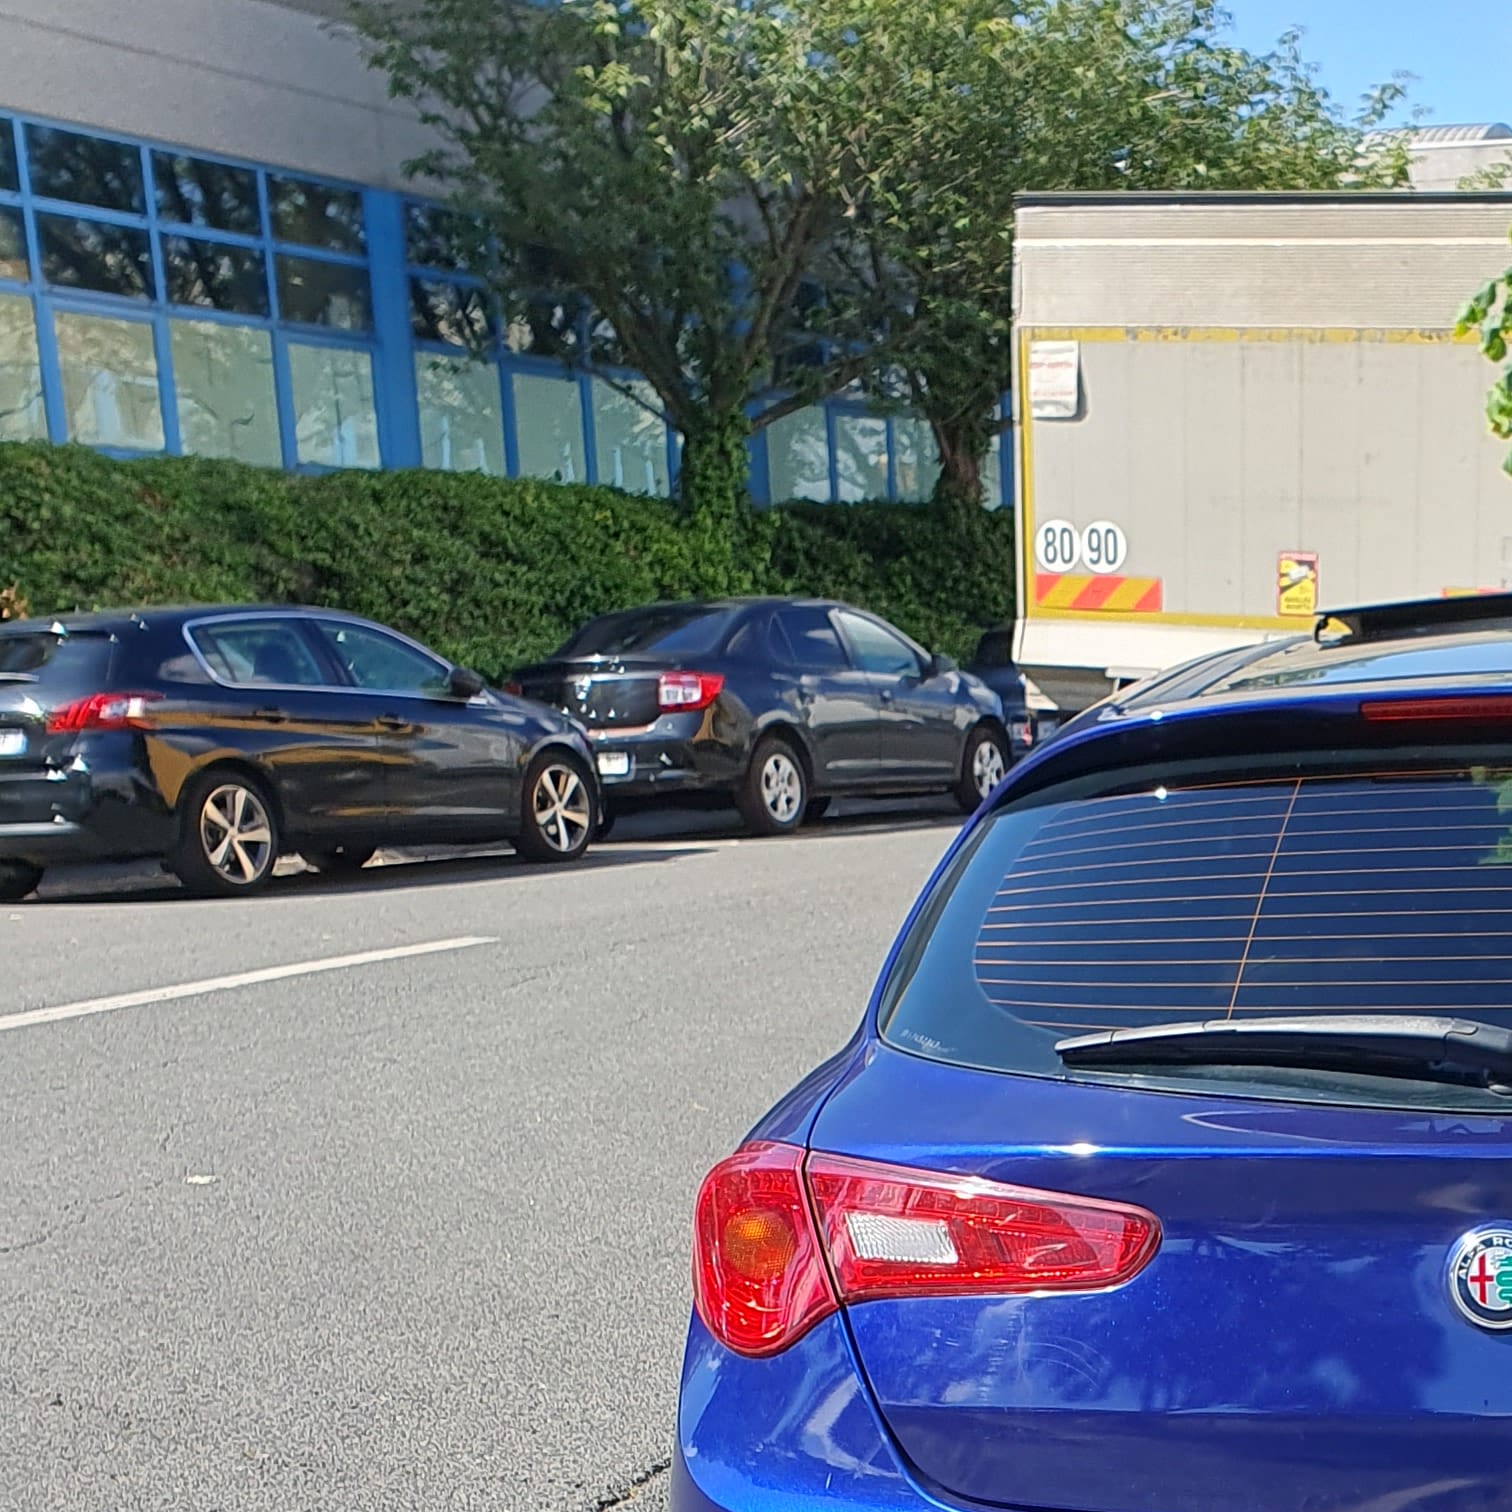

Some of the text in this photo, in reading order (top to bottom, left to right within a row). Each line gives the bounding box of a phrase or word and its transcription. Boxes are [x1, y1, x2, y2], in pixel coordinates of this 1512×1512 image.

[1044, 527, 1118, 565] 80 90
[1458, 1243, 1487, 1280] ALFA
